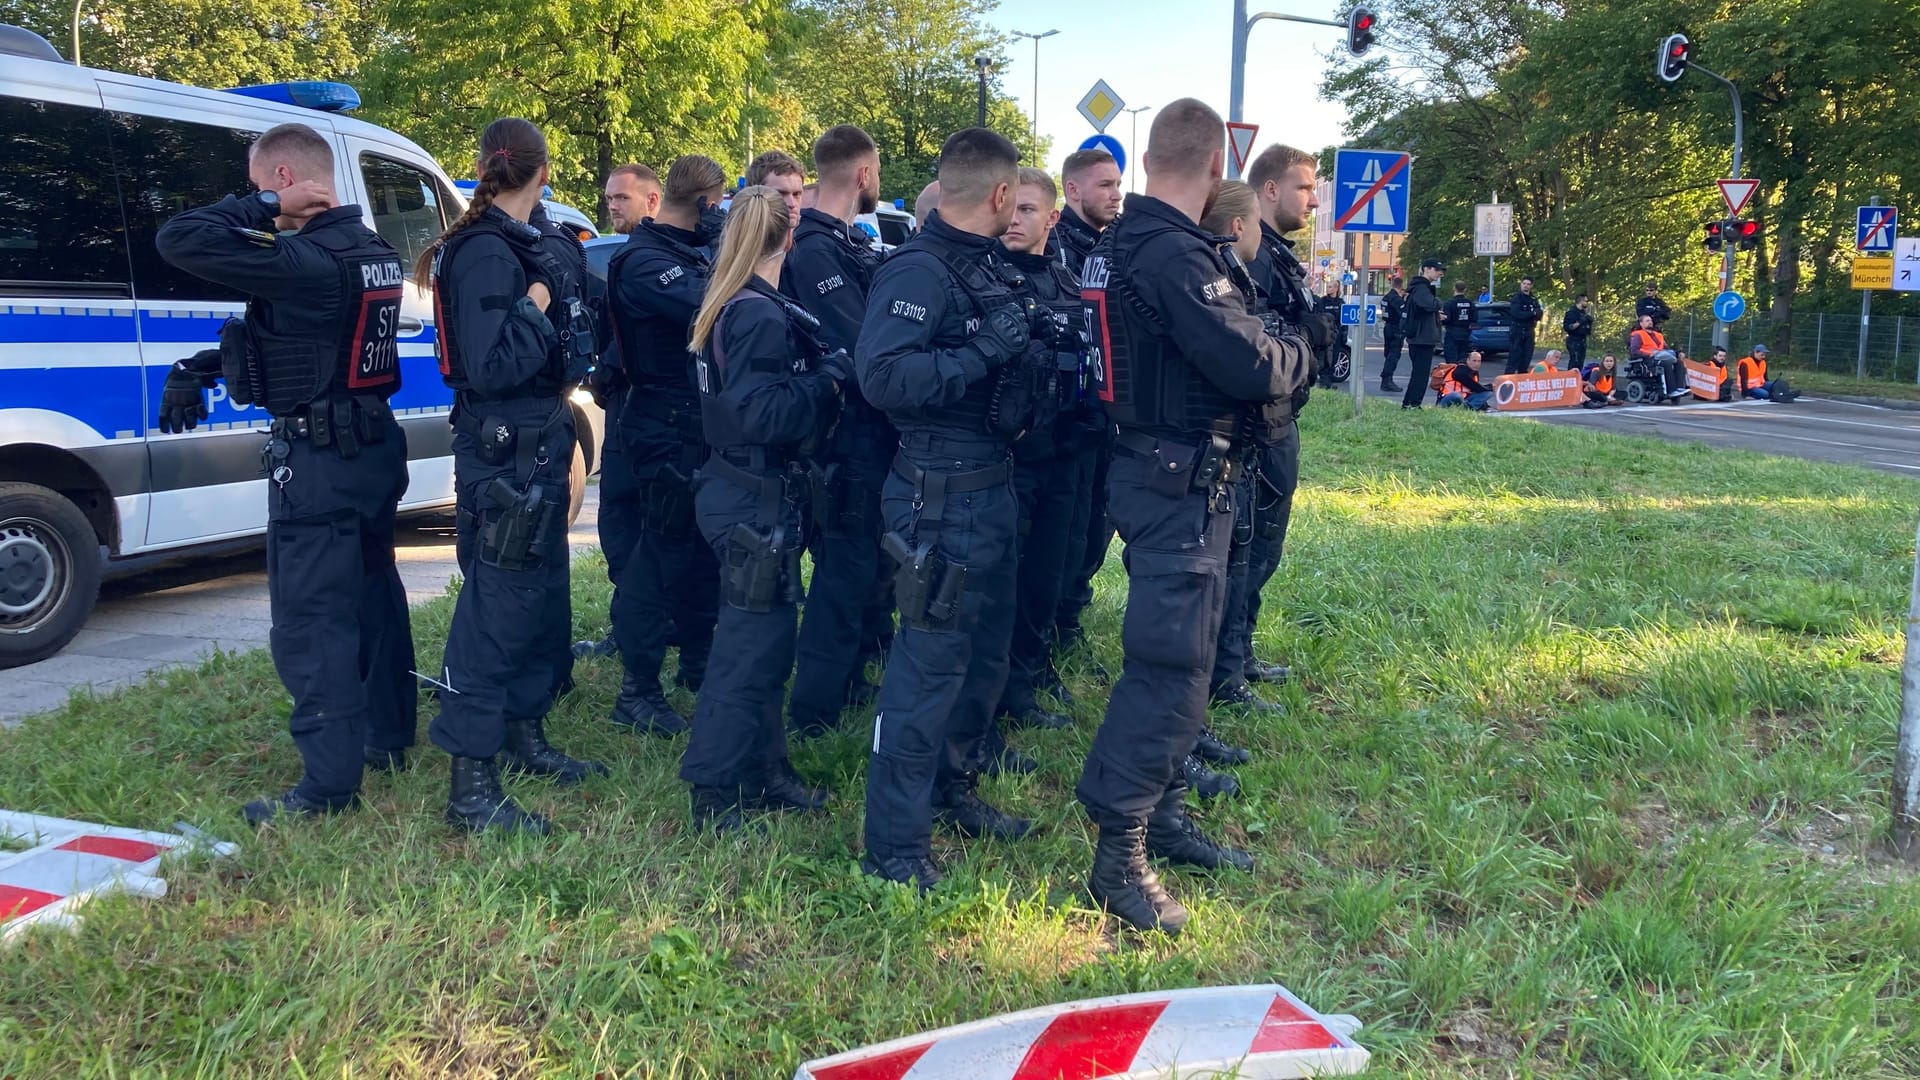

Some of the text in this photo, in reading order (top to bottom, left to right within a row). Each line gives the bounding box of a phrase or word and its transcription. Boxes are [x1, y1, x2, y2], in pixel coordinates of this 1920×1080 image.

[660, 273, 671, 285] ST
[1854, 273, 1891, 283] München
[817, 281, 828, 294] ST
[1203, 283, 1216, 299] ST
[893, 300, 926, 321] ST 31112
[378, 305, 396, 338] ST
